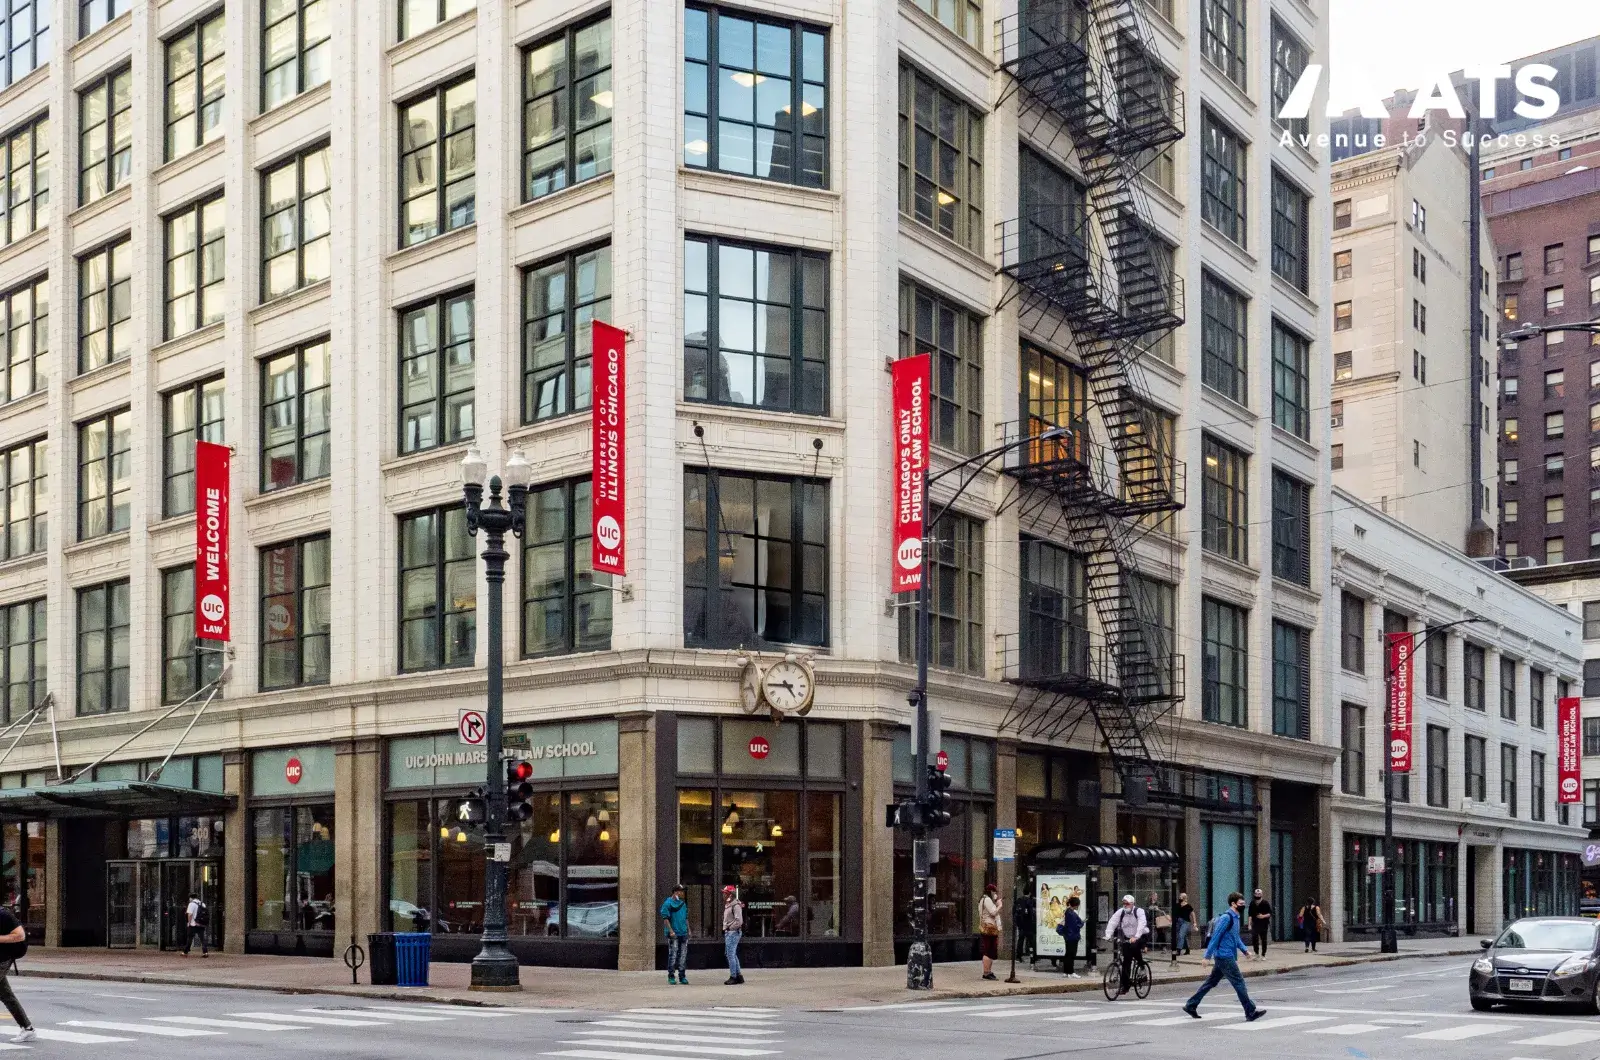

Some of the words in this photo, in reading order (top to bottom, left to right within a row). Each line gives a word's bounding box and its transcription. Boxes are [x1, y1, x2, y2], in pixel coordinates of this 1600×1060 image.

[608, 348, 618, 426] CHICAGO
[600, 399, 607, 415] OF
[912, 377, 922, 436] SCHOOL
[901, 409, 911, 445] ONLY
[912, 439, 922, 469] LAW
[608, 430, 618, 501] ILLINOIS
[901, 447, 911, 524] CHICAGO'S
[912, 471, 922, 522] PUBLIC
[206, 488, 220, 581] WELCOME
[600, 525, 618, 540] UIC
[600, 553, 618, 566] LAW
[901, 547, 922, 560] UIC
[900, 574, 922, 585] LAW
[203, 602, 222, 613] UIC
[203, 624, 223, 634] LAW
[1398, 691, 1407, 731] ILLINOIS
[406, 755, 424, 768] UIC
[424, 753, 453, 768] JOHN
[517, 746, 544, 760] LAW
[545, 741, 597, 758] SCHOOL
[750, 744, 768, 753] UIC
[938, 757, 947, 766] UIC
[1391, 760, 1406, 768] LAW
[287, 766, 300, 776] UIC
[192, 827, 208, 840] 300
